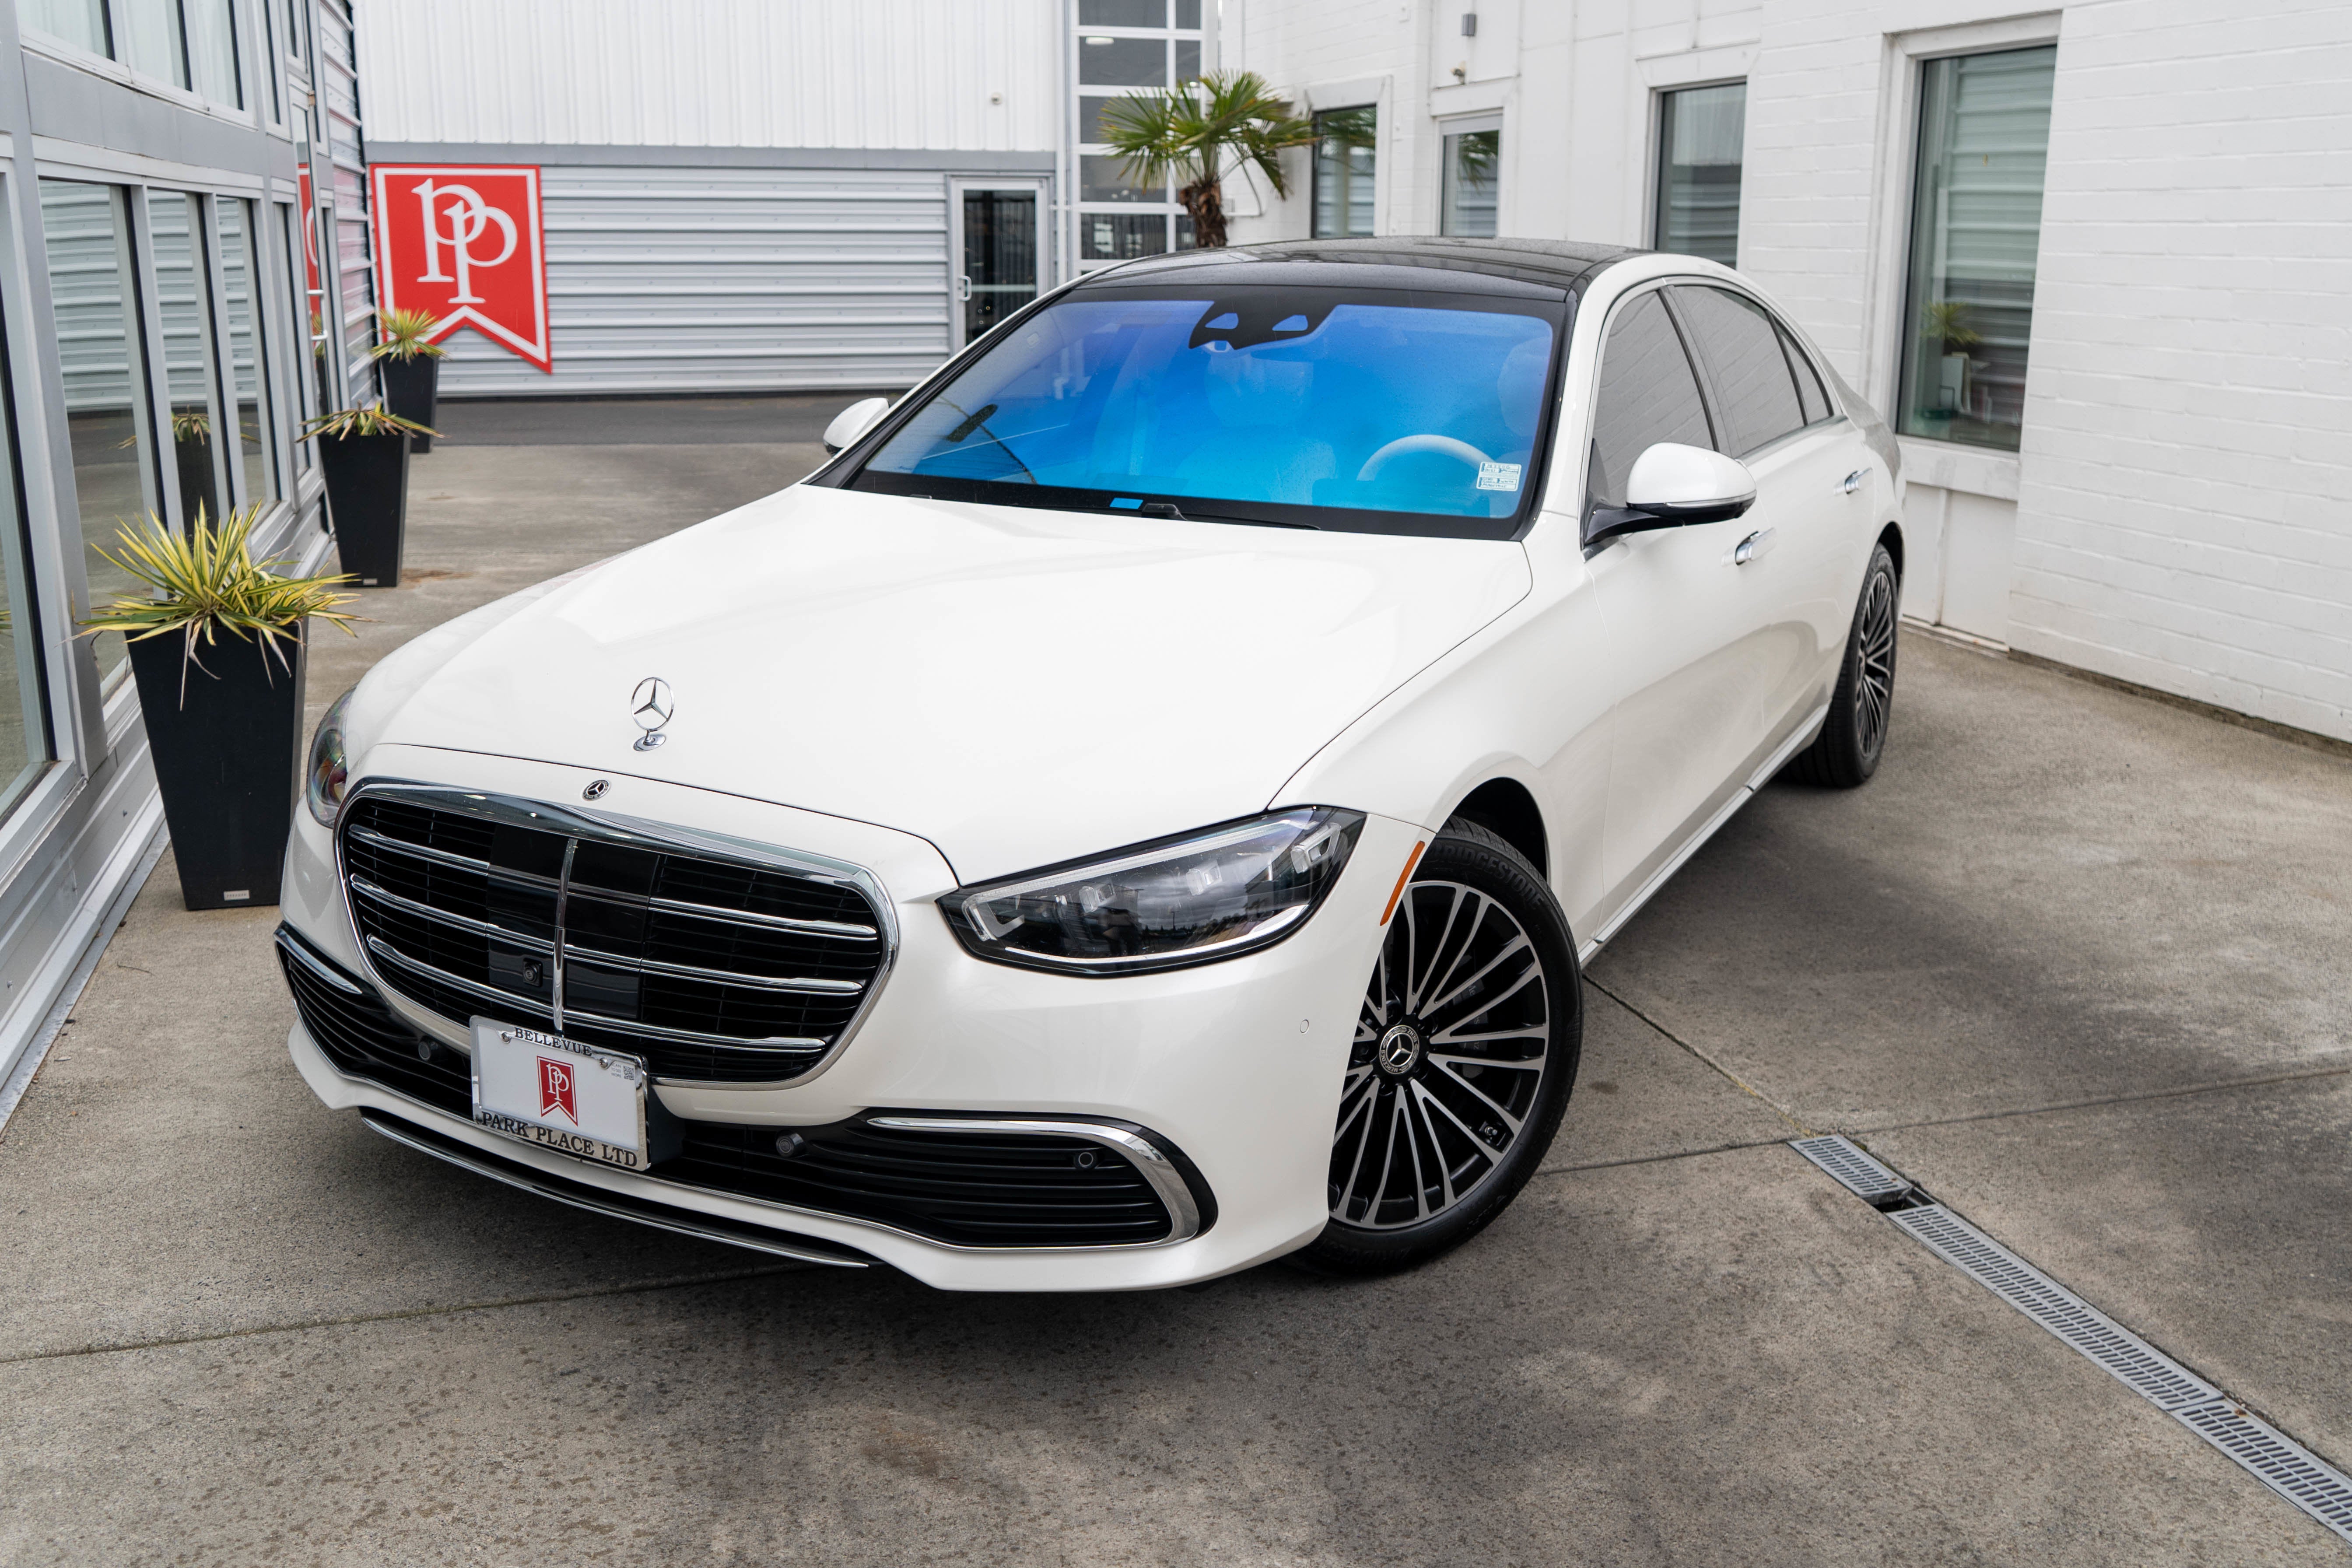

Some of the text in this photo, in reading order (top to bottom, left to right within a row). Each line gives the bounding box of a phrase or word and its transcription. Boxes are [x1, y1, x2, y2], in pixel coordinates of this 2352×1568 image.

[514, 1027, 592, 1057] BELLEVUE
[482, 1111, 638, 1168] PARK PLACE LTD
